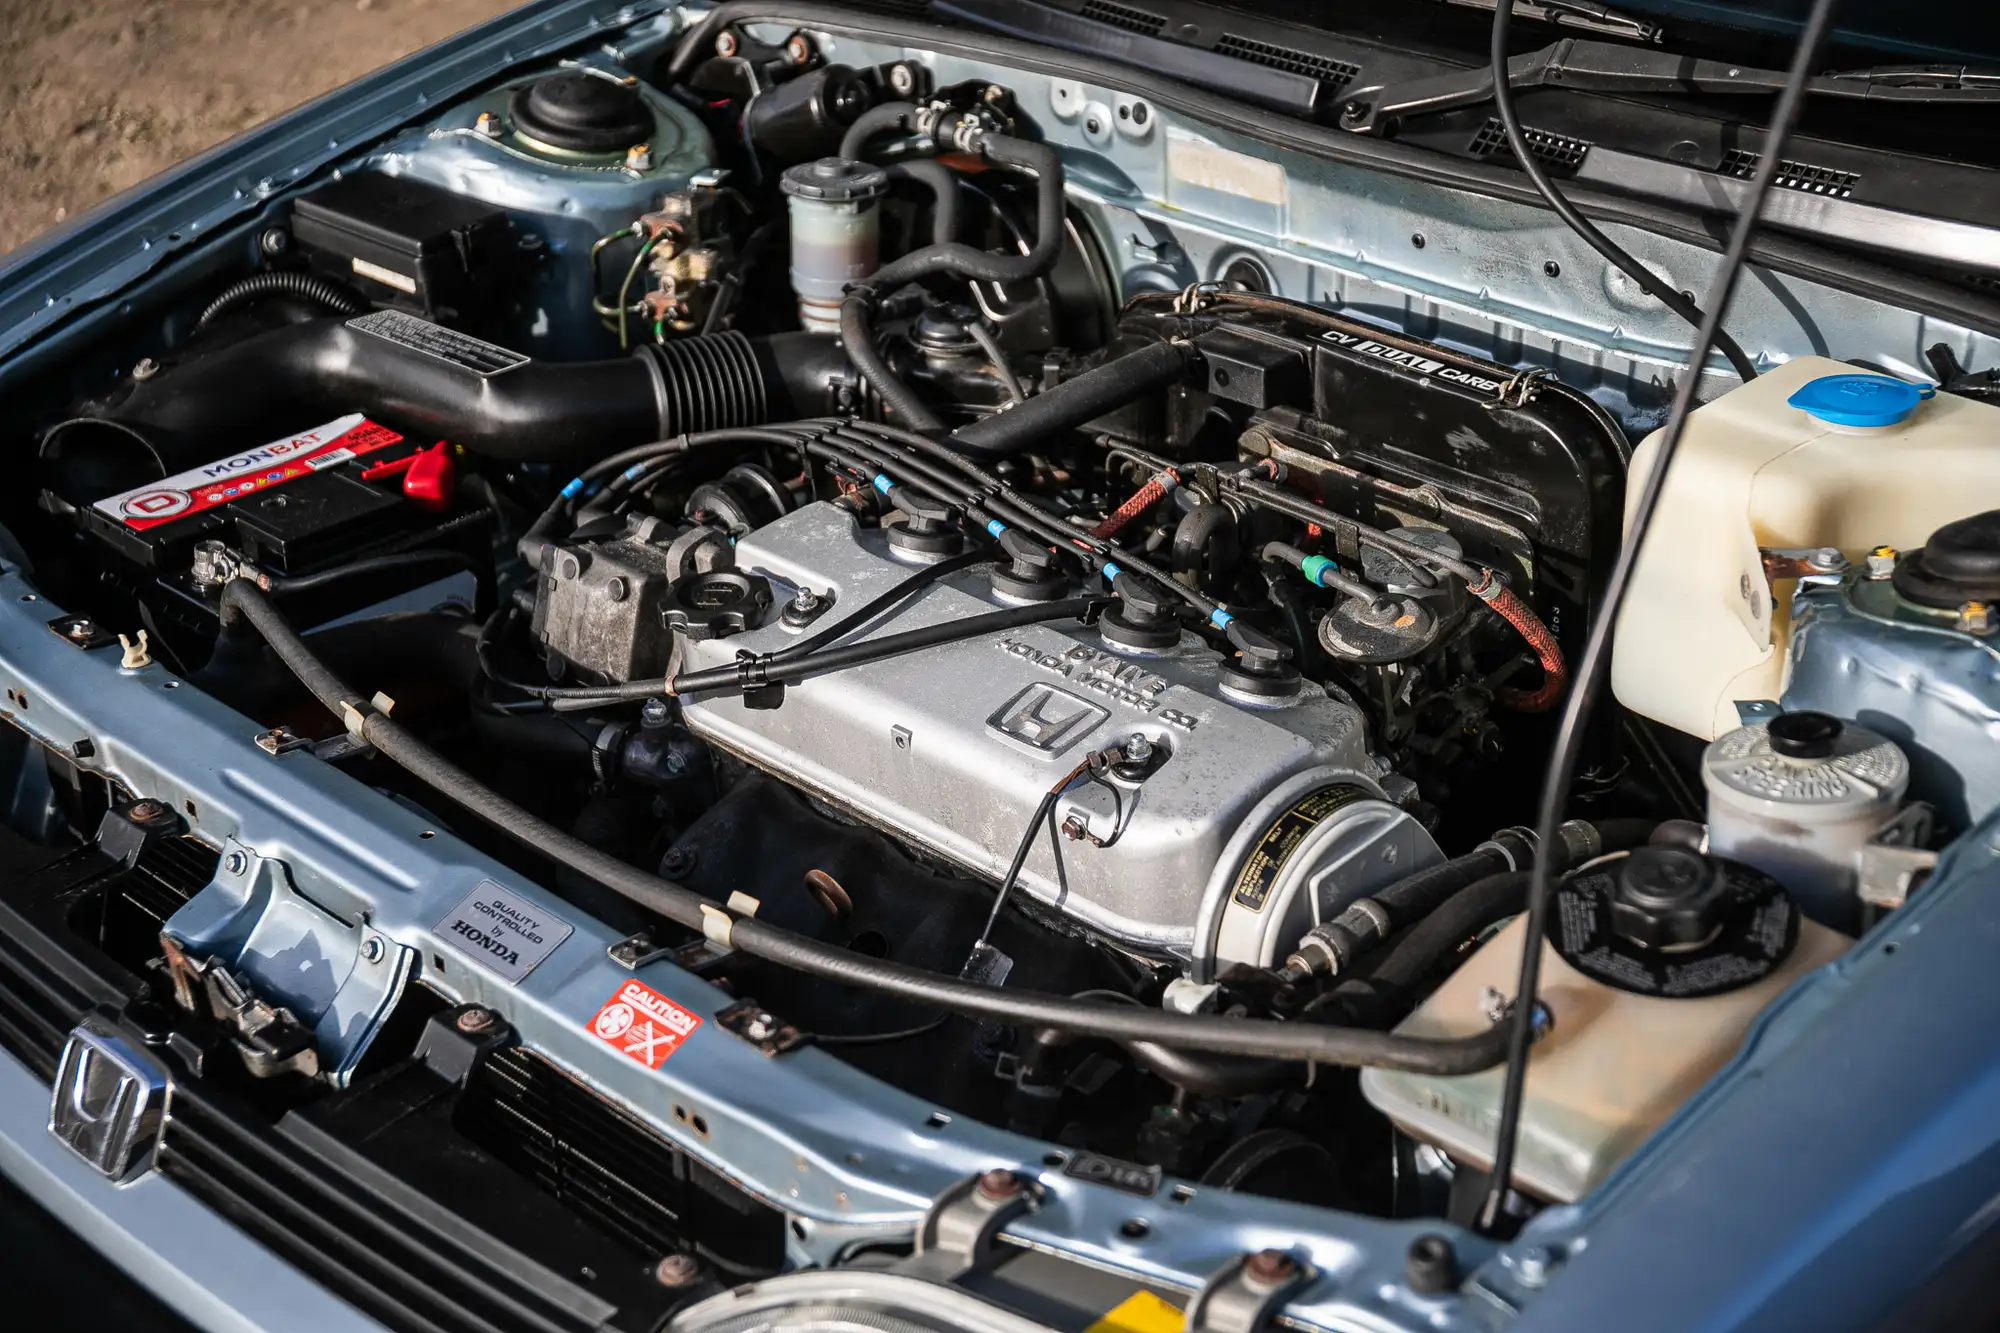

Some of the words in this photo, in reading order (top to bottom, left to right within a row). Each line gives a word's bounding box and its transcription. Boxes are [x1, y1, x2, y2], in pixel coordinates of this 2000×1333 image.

[1322, 330, 1358, 345] CV
[1362, 343, 1428, 372] DUAL
[202, 431, 322, 478] MONBAT
[135, 493, 179, 514] D
[994, 638, 1074, 678] HONDA
[1072, 672, 1161, 714] MOTOR
[473, 901, 544, 945] CONTROLLED
[490, 925, 505, 938] by
[492, 900, 541, 929] QUALITY
[450, 919, 520, 967] HONDA
[623, 983, 697, 1031] CAUTION
